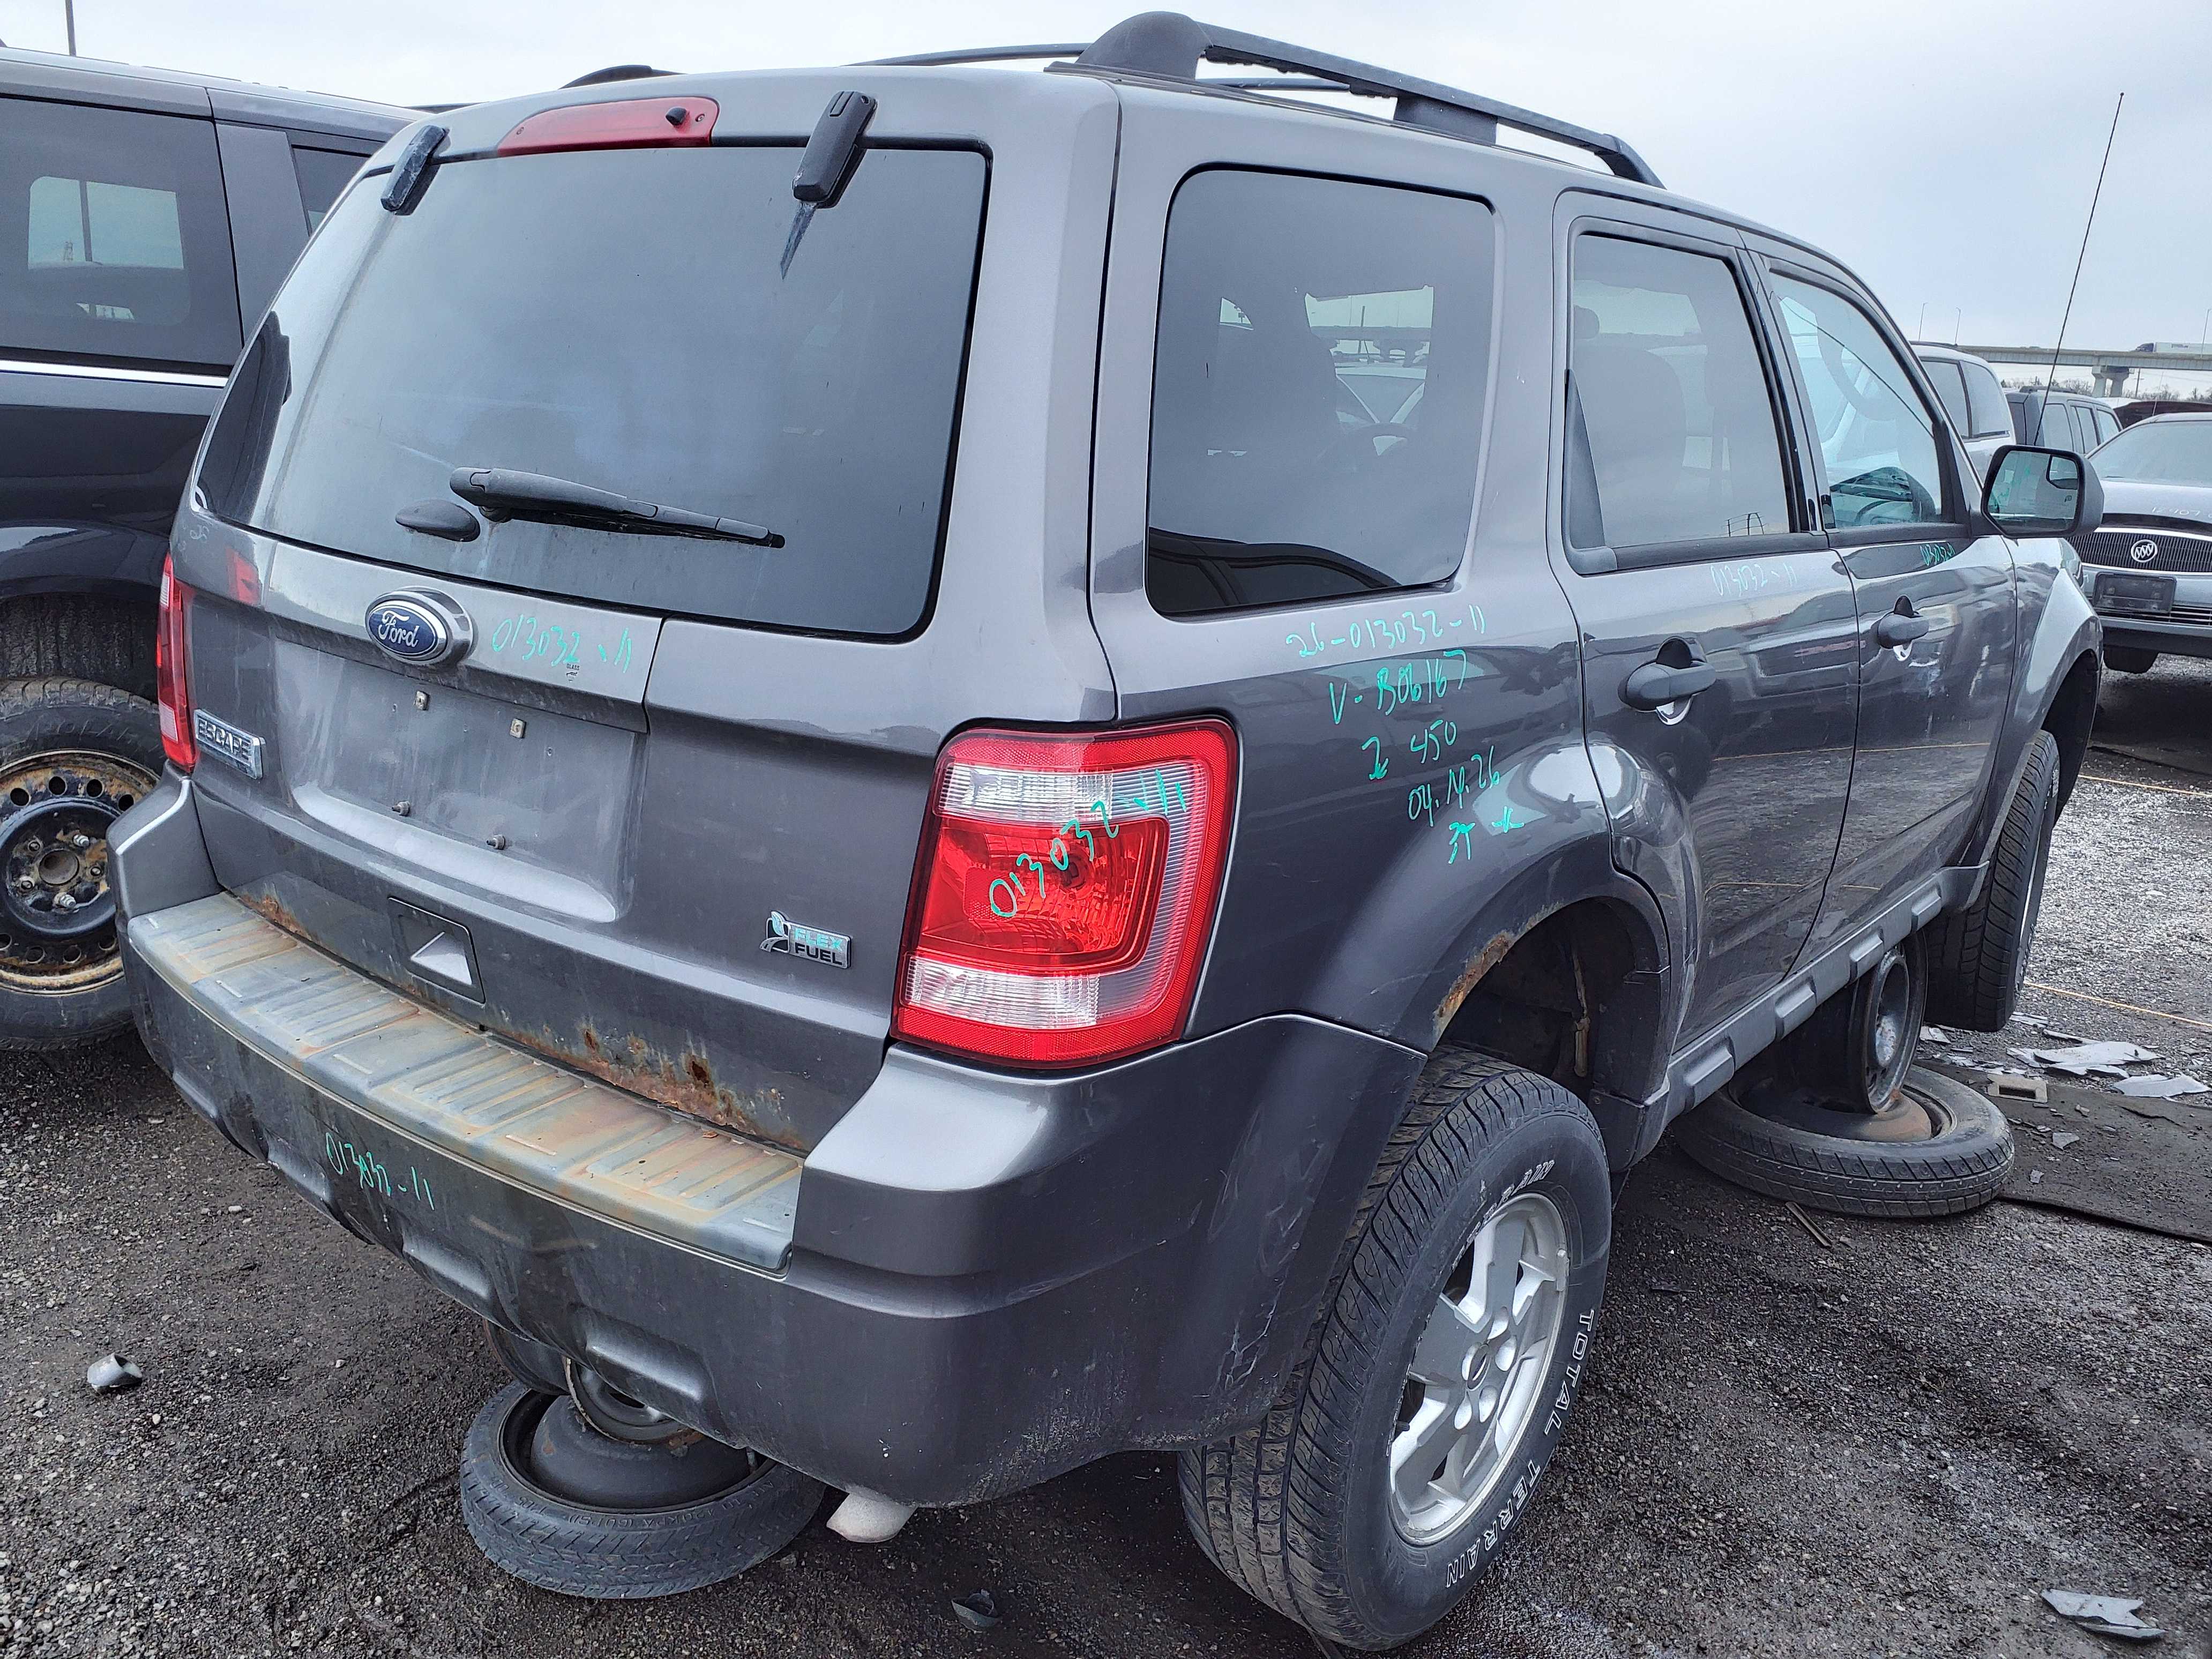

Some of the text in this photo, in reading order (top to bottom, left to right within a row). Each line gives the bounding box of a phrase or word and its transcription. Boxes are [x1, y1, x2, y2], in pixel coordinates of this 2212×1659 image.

[378, 610, 420, 647] Ford
[1286, 604, 1486, 657] 26-013032-11
[198, 715, 252, 761] ESCAPE
[1410, 719, 1458, 764] 450
[794, 927, 843, 952] FLEX
[795, 942, 843, 966] FUEL
[1544, 1309, 1595, 1436] TOTAL
[1445, 1459, 1541, 1588] TERRAIN
